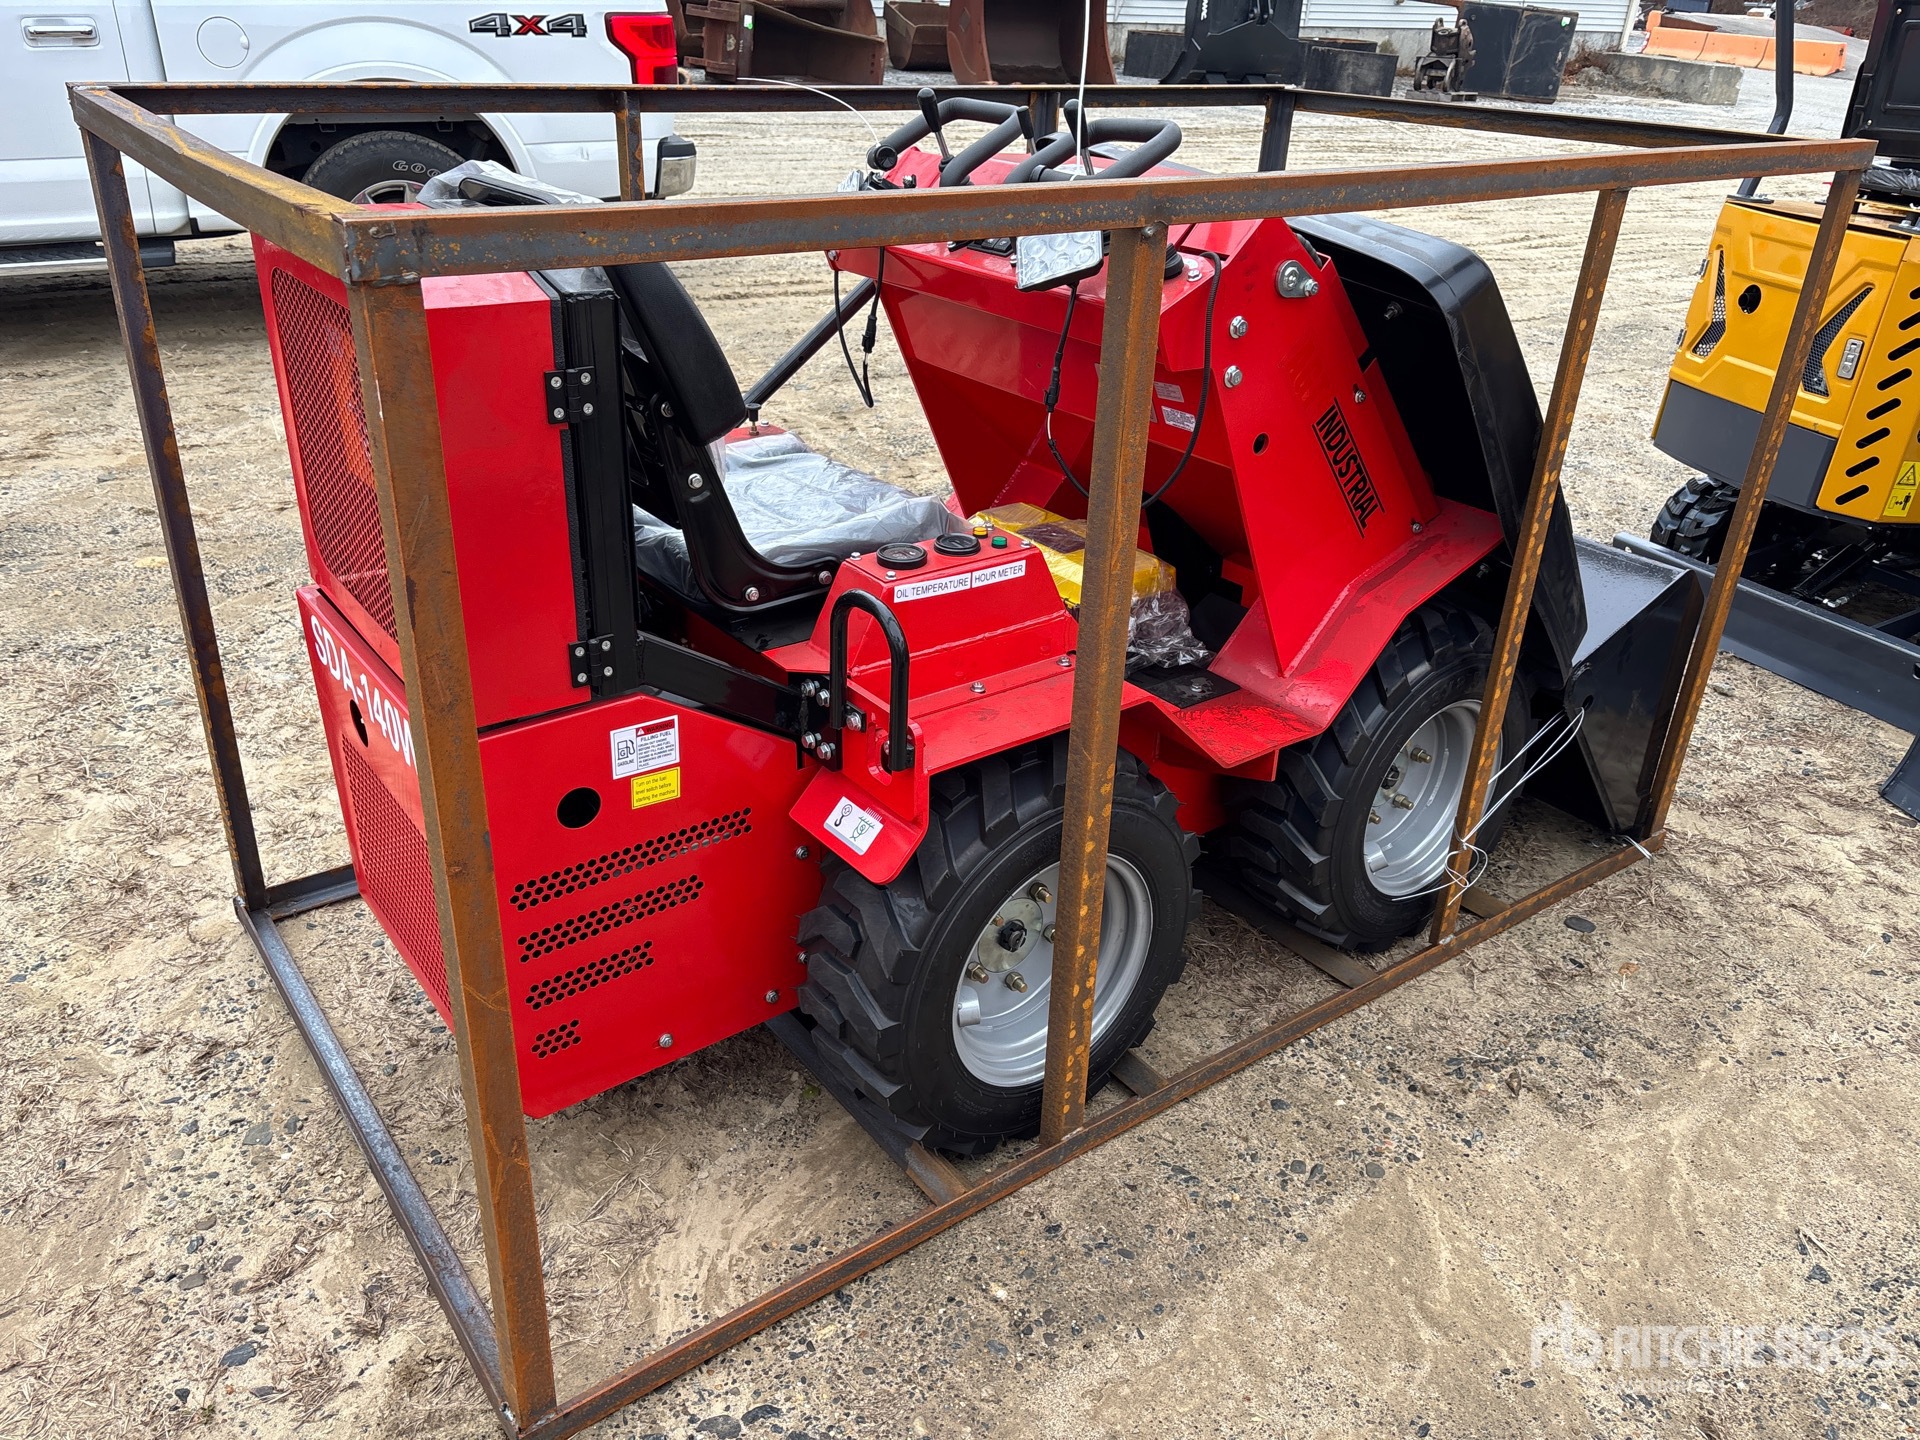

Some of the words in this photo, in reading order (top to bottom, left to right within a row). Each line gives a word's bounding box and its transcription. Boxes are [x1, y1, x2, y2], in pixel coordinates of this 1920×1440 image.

[1315, 403, 1379, 530] INDUSTRIAL
[974, 570, 997, 584] HOUR
[998, 564, 1024, 578] METER
[896, 588, 909, 600] OIL
[911, 576, 969, 597] TEMPERATURE
[646, 722, 672, 733] WARNING
[641, 734, 659, 742] FILLING
[617, 759, 634, 767] GASOLINE
[636, 780, 645, 788] Turn
[646, 785, 658, 793] switch
[659, 788, 675, 797] machine
